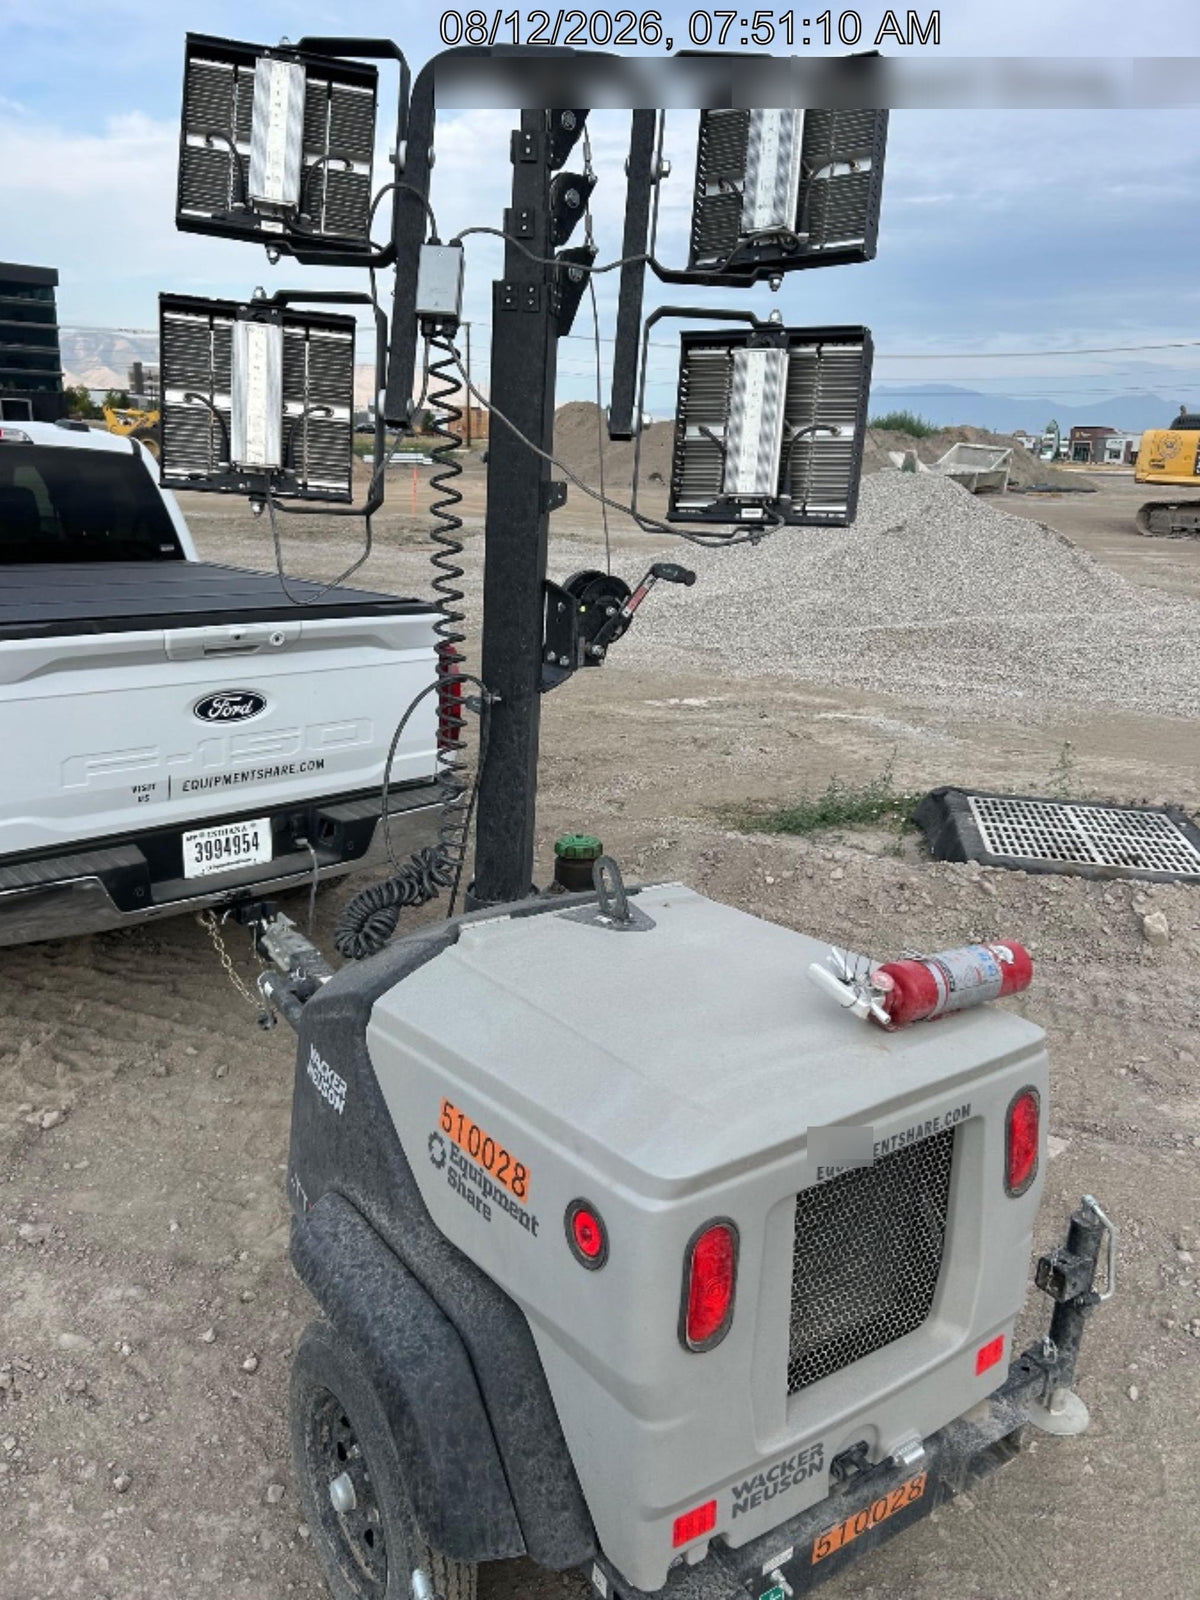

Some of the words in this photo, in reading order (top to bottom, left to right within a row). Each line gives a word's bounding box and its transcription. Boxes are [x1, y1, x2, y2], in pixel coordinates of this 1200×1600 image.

[208, 696, 253, 718] Ford
[60, 718, 373, 788] F-150
[182, 758, 325, 792] EQUIPMENTSHARE.COM
[131, 783, 156, 794] VISIT
[137, 794, 150, 803] US
[194, 831, 259, 863] 3994954
[310, 1042, 347, 1099] WACKER
[441, 1101, 527, 1198] 510028
[447, 1166, 492, 1222] Share
[449, 1141, 540, 1238] Equipment
[731, 1442, 825, 1500] WACKER
[731, 1457, 824, 1519] NEUSON
[816, 1474, 924, 1559] 510028
